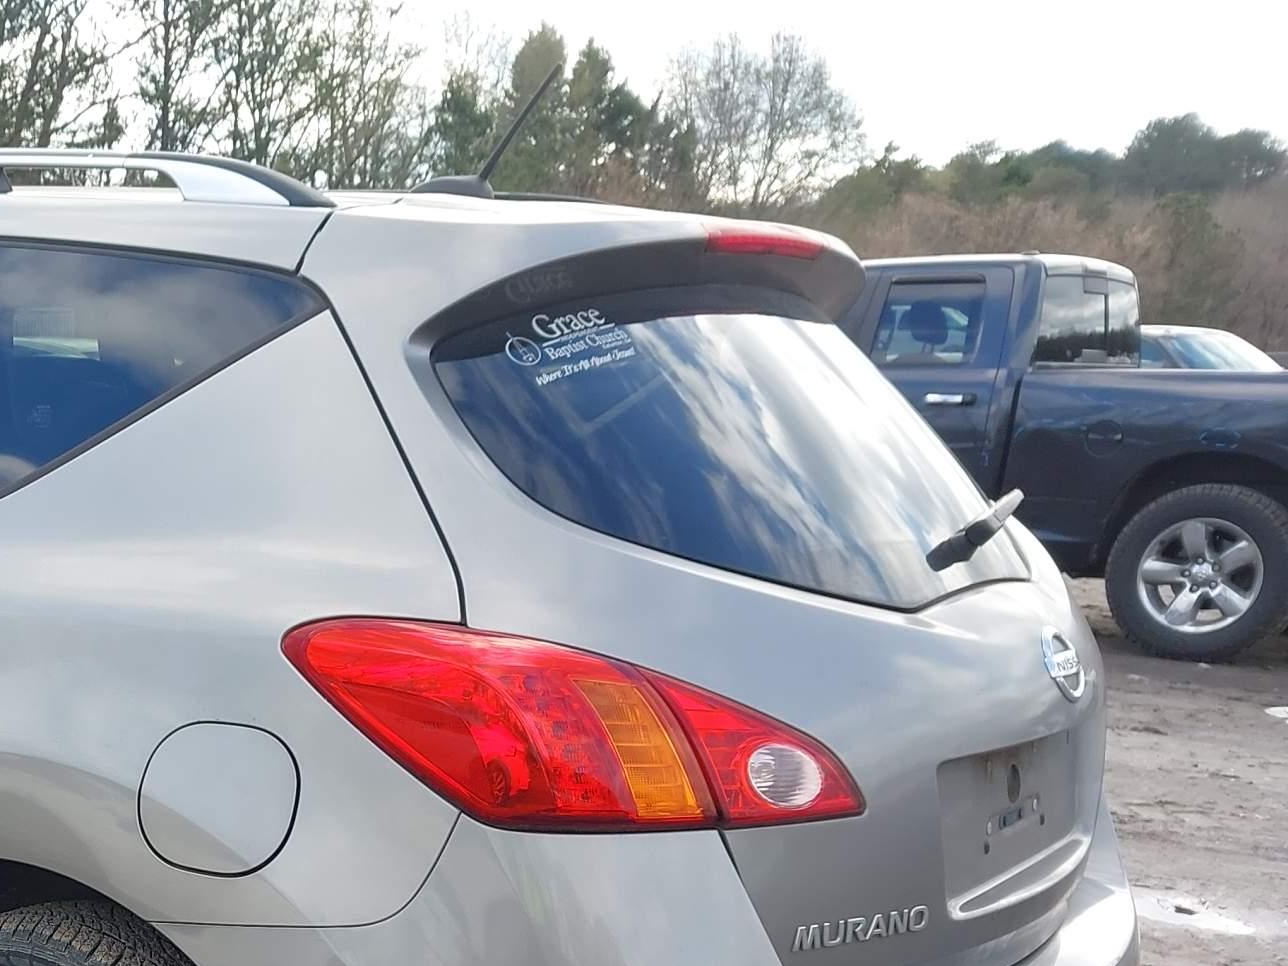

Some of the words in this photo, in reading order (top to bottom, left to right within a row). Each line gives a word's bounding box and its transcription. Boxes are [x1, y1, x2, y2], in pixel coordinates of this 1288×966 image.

[531, 308, 605, 338] Grace
[544, 340, 589, 360] Baptist
[585, 328, 628, 346] Church
[791, 904, 929, 952] MURANO
